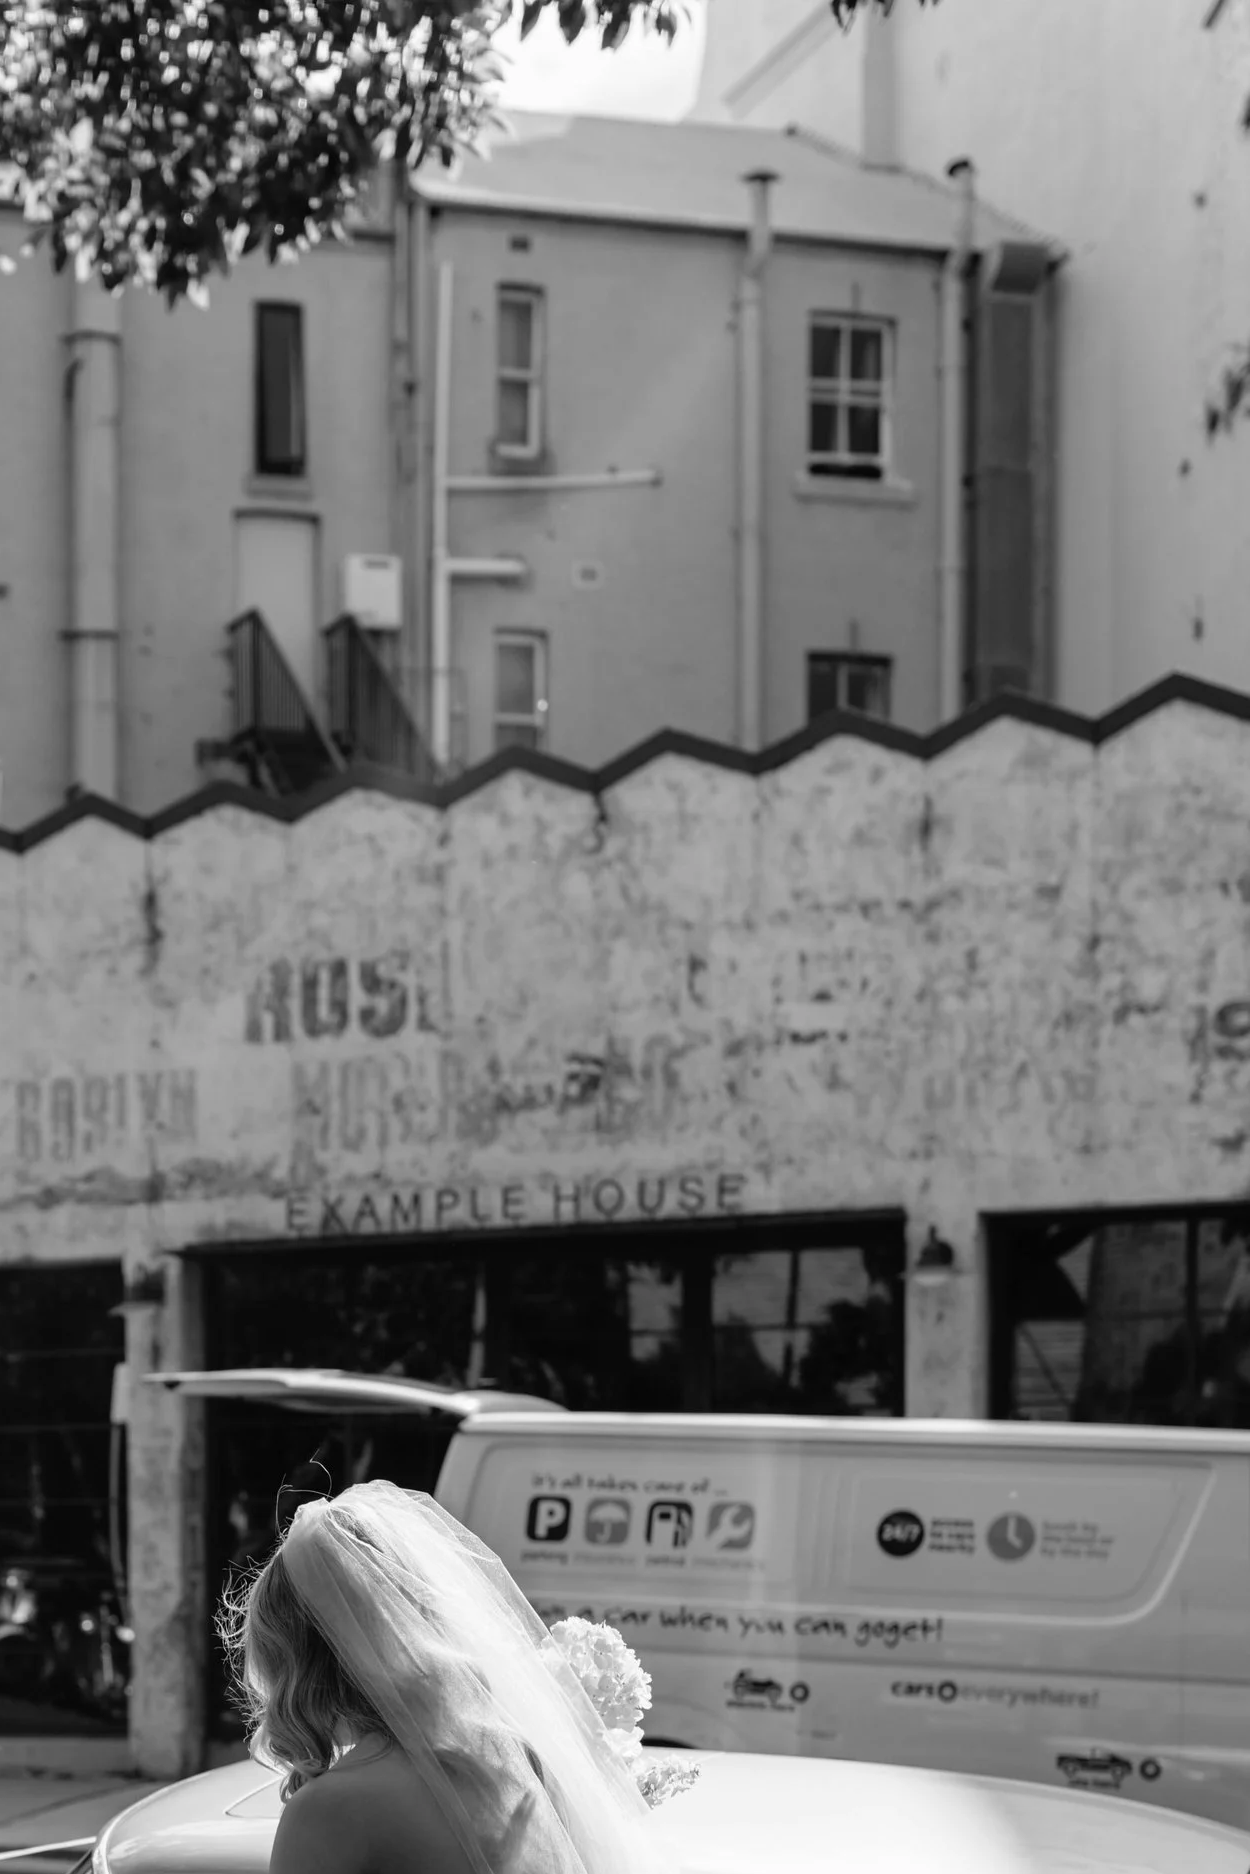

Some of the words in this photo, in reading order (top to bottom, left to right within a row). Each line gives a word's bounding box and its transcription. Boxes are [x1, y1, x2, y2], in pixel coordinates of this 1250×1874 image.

[284, 1183, 526, 1234] EXAMPLE
[553, 1173, 747, 1221] HOUSE
[604, 1606, 651, 1626] car
[659, 1604, 728, 1634] when
[737, 1615, 786, 1640] you
[793, 1616, 848, 1639] can
[854, 1615, 944, 1649] goget!
